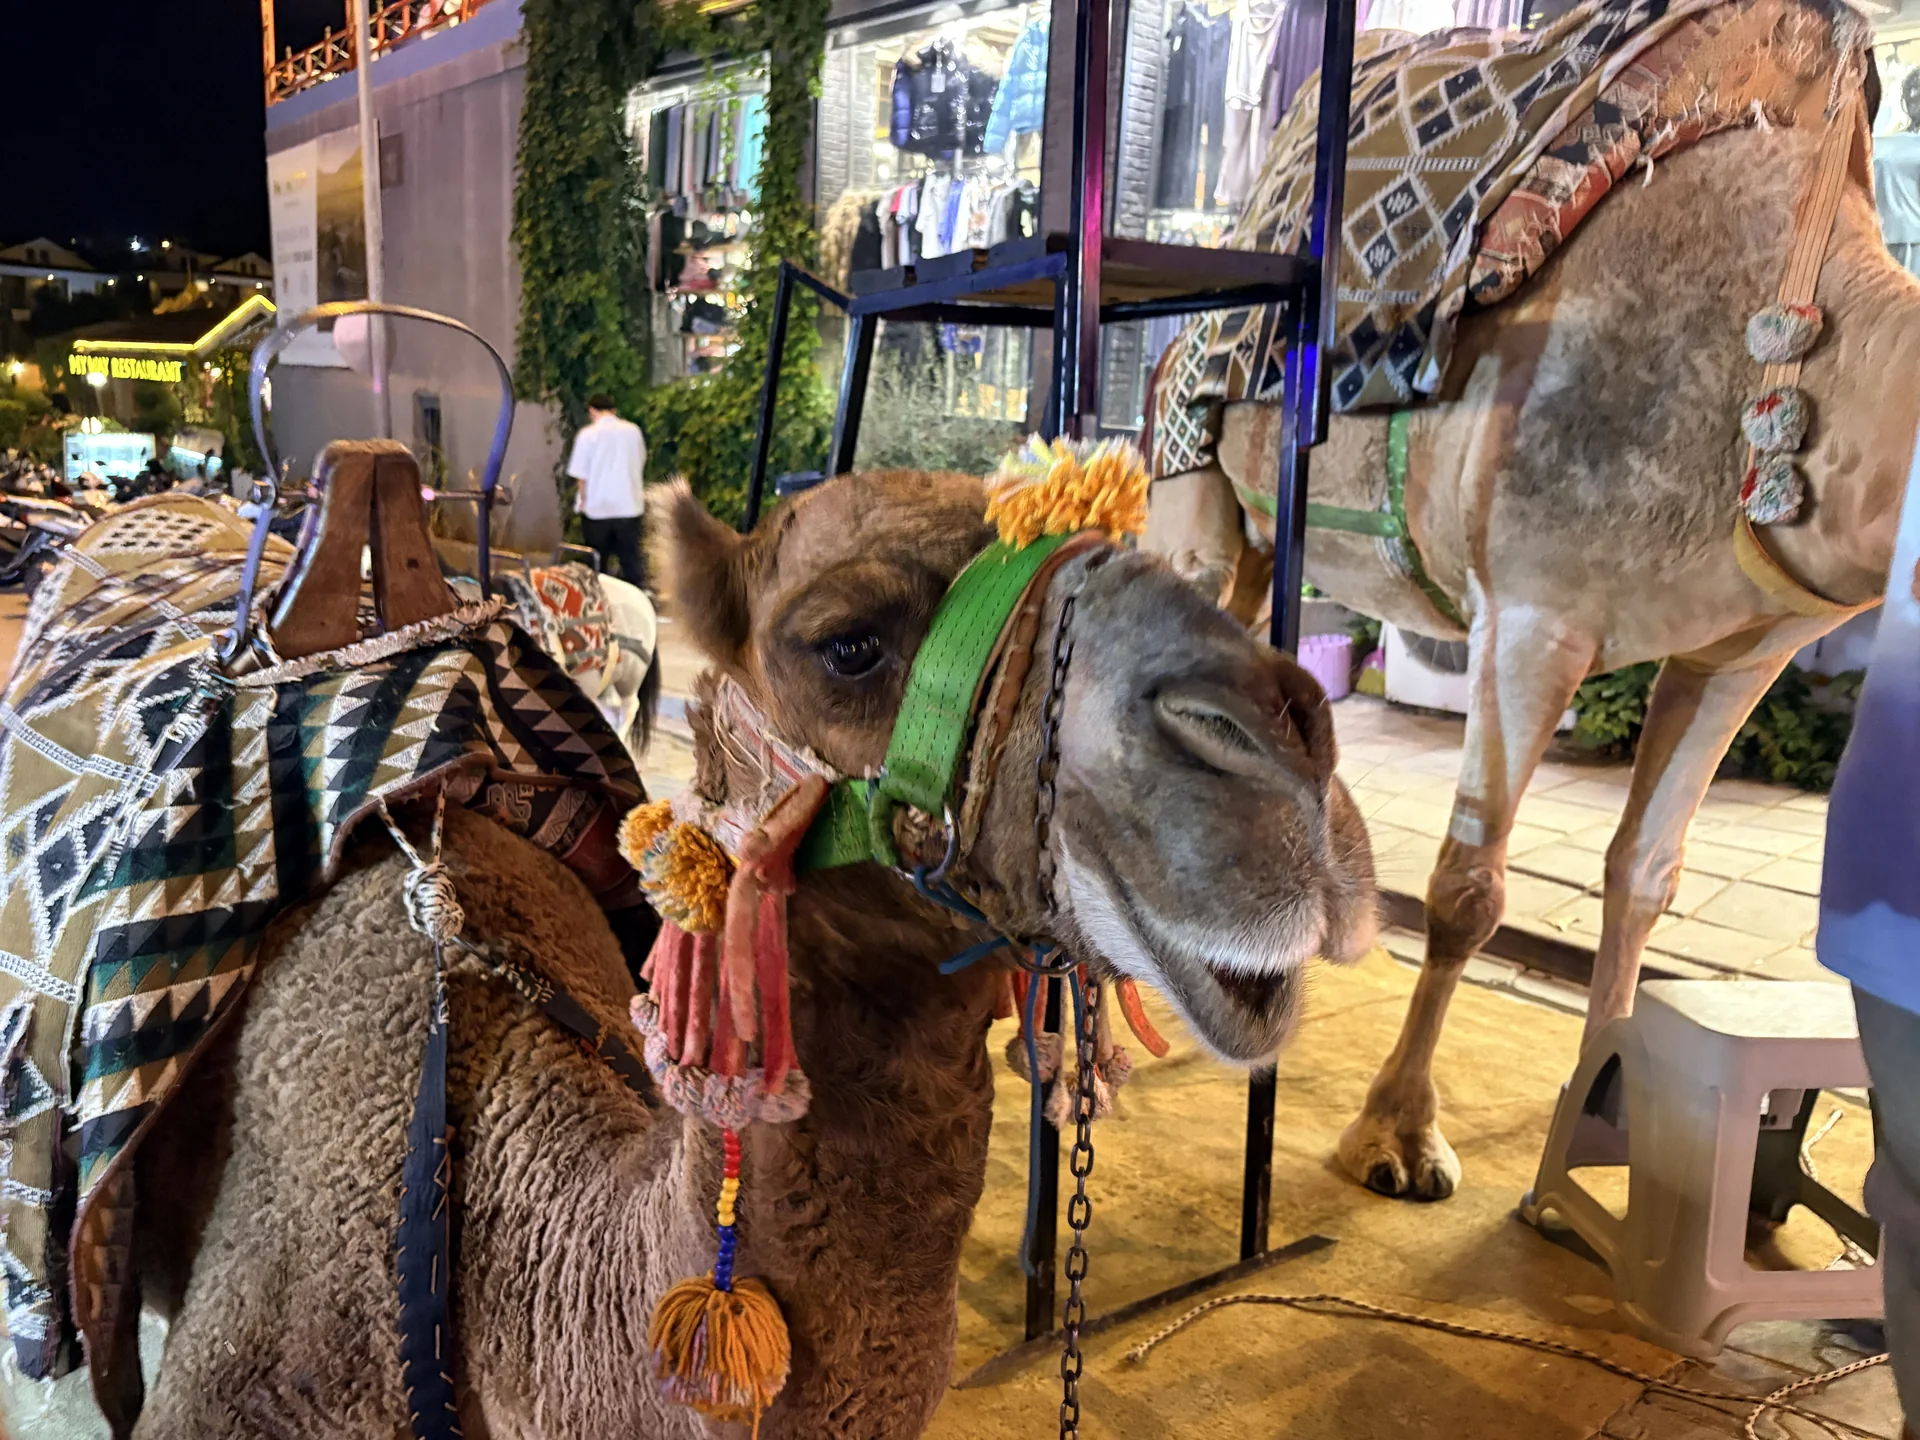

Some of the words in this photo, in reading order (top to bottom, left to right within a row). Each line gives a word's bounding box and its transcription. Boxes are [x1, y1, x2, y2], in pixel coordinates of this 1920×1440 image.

[69, 354, 87, 375] MY
[87, 355, 109, 377] WAY
[111, 357, 182, 382] RESTAURANT
